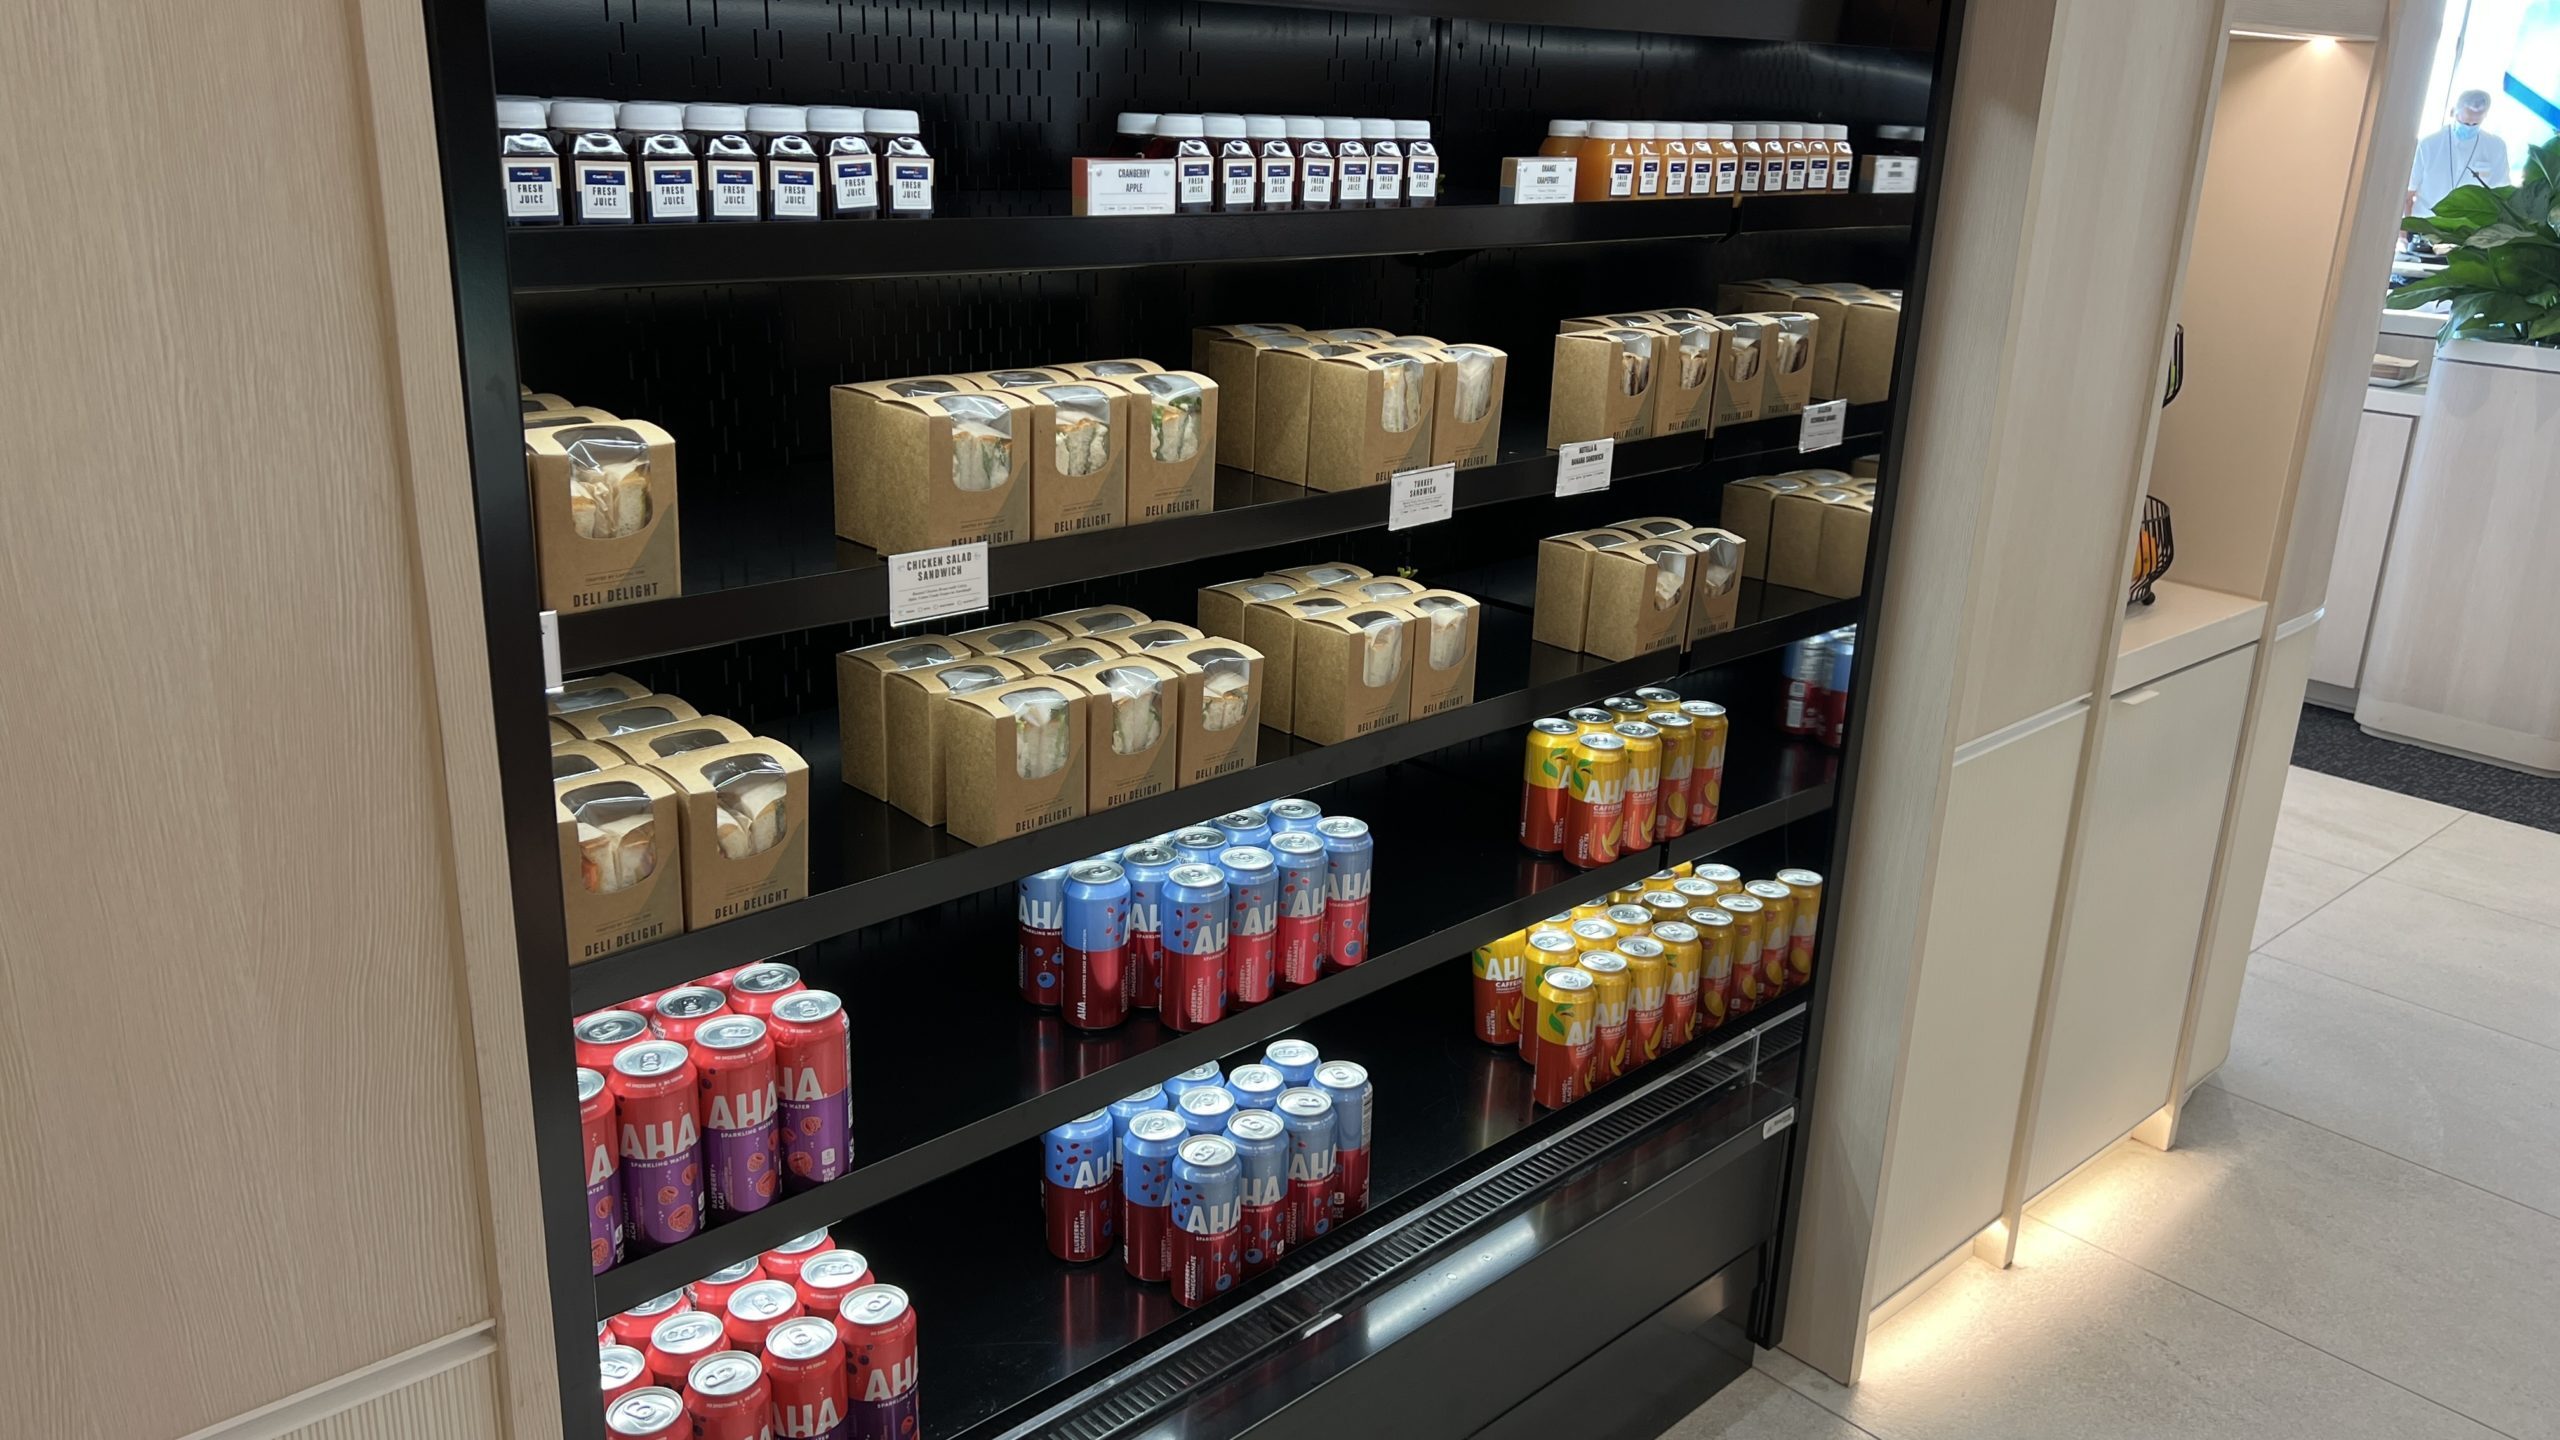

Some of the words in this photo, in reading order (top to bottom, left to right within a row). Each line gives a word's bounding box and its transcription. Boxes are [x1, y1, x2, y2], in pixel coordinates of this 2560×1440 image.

[1118, 168, 1151, 178] CRANBERRY
[1542, 164, 1557, 172] ORANGE
[517, 184, 543, 193] FRESH
[845, 179, 866, 187] FRESH
[901, 181, 921, 189] FRESH
[1126, 183, 1143, 193] APPLE
[592, 187, 617, 196] FRESH
[661, 186, 685, 195] FRESH
[723, 186, 745, 194] FRESH
[784, 186, 806, 194] FRESH
[846, 188, 866, 197] JUICE
[902, 190, 921, 199] JUICE
[519, 195, 543, 204] JUICE
[593, 198, 617, 207] JUICE
[663, 196, 685, 205] JUICE
[724, 196, 745, 205] JUICE
[785, 196, 806, 205] JUICE
[1463, 455, 1488, 467] DELIGHT
[1376, 471, 1390, 482] DELI
[1414, 478, 1434, 488] TURKEY
[1409, 486, 1436, 498] SANDWICH
[1145, 505, 1164, 517] DELI
[1167, 499, 1200, 514] DELIGHT
[1054, 521, 1073, 533] DELI
[1077, 513, 1112, 529] DELIGHT
[907, 558, 943, 571] CHICKEN
[946, 552, 972, 565] SALAD
[918, 566, 962, 581] SANDWICH
[573, 593, 601, 608] DELI
[608, 582, 659, 602] DELIGHT
[1423, 703, 1437, 714] DELI
[1439, 695, 1463, 710] DELIGHT
[1357, 722, 1372, 733] DELI
[1374, 713, 1399, 729] DELIGHT
[1195, 768, 1212, 780] DELI
[1214, 758, 1245, 775] DELIGHT
[1108, 794, 1126, 806] DELI
[1129, 783, 1162, 800] DELIGHT
[1016, 820, 1035, 833] DELI
[1038, 807, 1073, 826] DELIGHT
[715, 903, 739, 920] DELI
[744, 888, 789, 911] DELIGHT
[1290, 884, 1325, 917] AH
[1242, 900, 1277, 936] AH
[584, 938, 611, 957] DELI
[616, 922, 664, 948] DELIGHT
[1193, 918, 1228, 955] AH
[1495, 979, 1522, 988] CAFFEIN
[708, 1081, 778, 1130] AHA
[620, 1112, 697, 1160] AHA
[720, 1128, 757, 1139] SPARKLING
[631, 1160, 669, 1168] SPARKLING
[669, 1152, 689, 1164] WATER
[1074, 1151, 1113, 1189] AH
[1241, 1176, 1281, 1206] HA
[1186, 1195, 1241, 1235] AHA
[1196, 1233, 1225, 1241] SPARKLING
